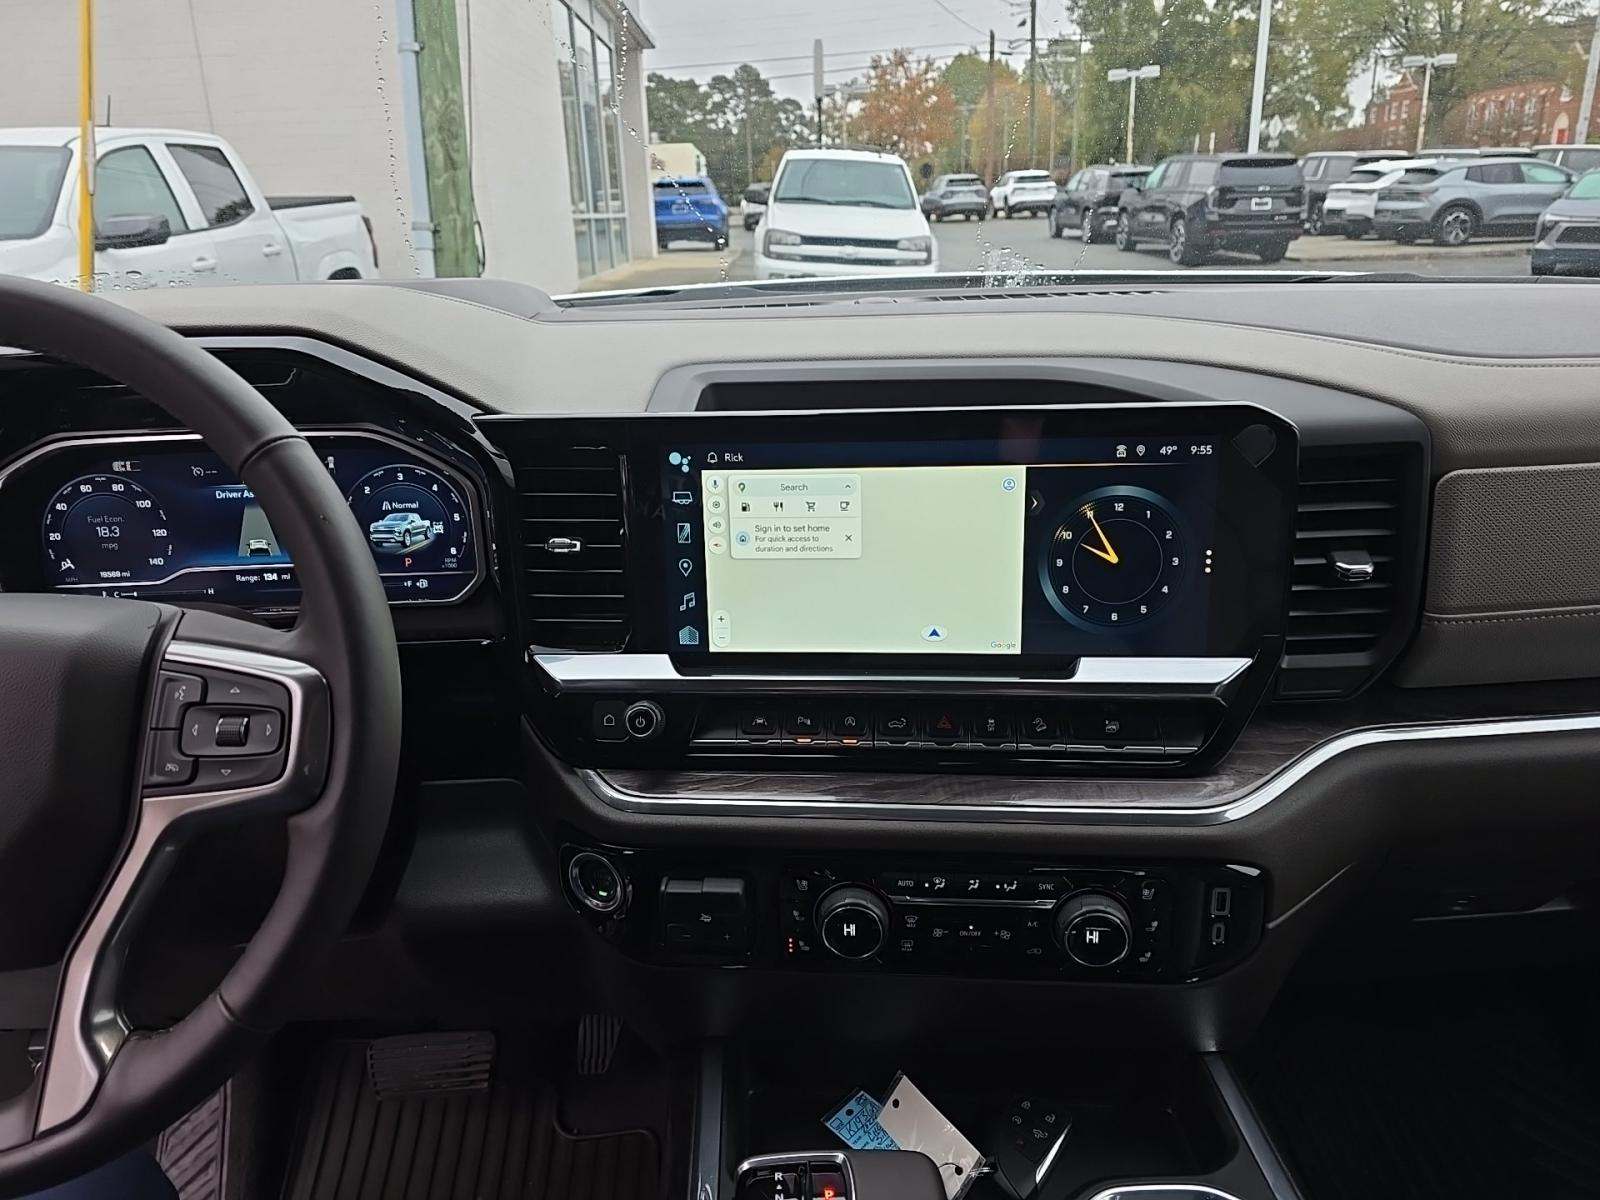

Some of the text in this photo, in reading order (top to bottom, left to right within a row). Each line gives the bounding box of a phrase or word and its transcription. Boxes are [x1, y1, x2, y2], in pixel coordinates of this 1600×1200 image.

[1190, 445, 1213, 455] 9:55
[724, 453, 744, 462] Rick
[397, 473, 403, 481] 3
[80, 484, 92, 493] 60
[112, 484, 124, 492] 80
[364, 486, 371, 494] 2
[432, 484, 438, 492] 4
[780, 483, 808, 491] Search
[216, 490, 242, 499] Driver
[56, 503, 67, 511] 40
[136, 500, 151, 508] 100
[392, 501, 419, 509] Normal
[1114, 503, 1124, 511] 12
[87, 515, 103, 523] Fuel
[453, 513, 460, 521] 5
[1146, 511, 1151, 519] 1
[96, 526, 120, 538] 18.3
[152, 529, 167, 537] 120
[755, 525, 773, 533] Sign
[50, 533, 61, 541] 20
[767, 535, 786, 543] quick
[1062, 531, 1072, 539] 10
[1166, 531, 1172, 539] 2
[102, 542, 119, 550] mpg
[450, 547, 457, 555] 6
[149, 558, 164, 566] 140
[404, 557, 413, 567] P
[1056, 559, 1063, 567] 9
[1172, 557, 1179, 566] 3
[236, 575, 261, 583] Range:
[263, 573, 278, 581] 134
[1162, 585, 1168, 593] 4
[1083, 605, 1089, 613] 7
[1111, 613, 1118, 621] 6
[990, 641, 1016, 649] Google
[1038, 883, 1055, 891] SYNC
[843, 924, 856, 937] HI
[1086, 930, 1099, 943] HI
[774, 1172, 783, 1181] R
[824, 1189, 835, 1200] P
